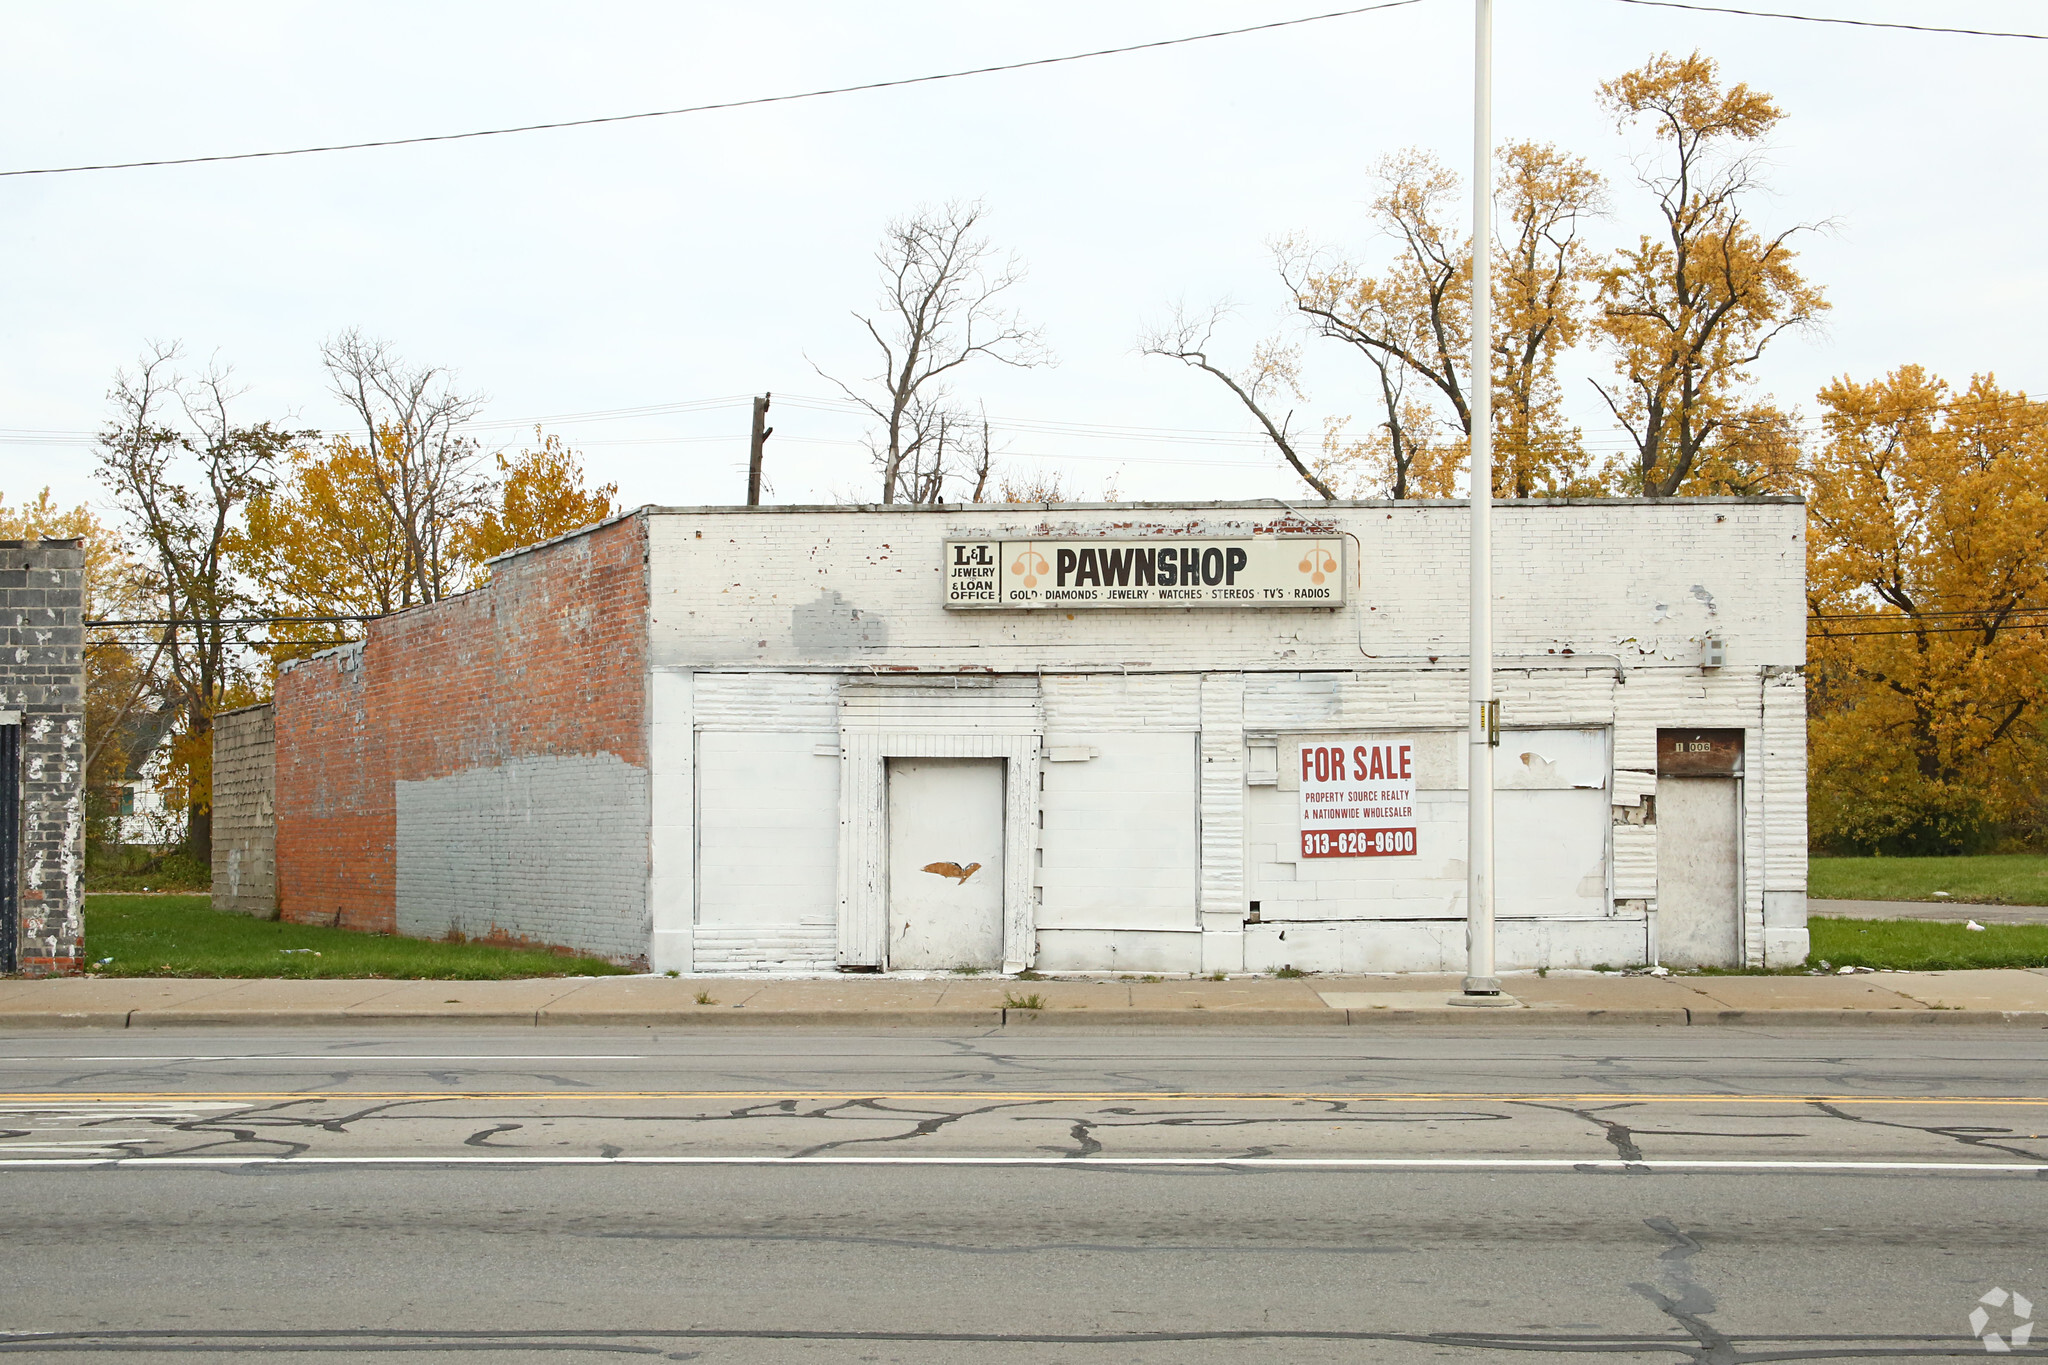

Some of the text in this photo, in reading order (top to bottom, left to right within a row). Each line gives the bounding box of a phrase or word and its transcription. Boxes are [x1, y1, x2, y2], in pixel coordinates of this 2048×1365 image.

[954, 546, 993, 566] L&L
[951, 567, 996, 578] JEWELRY
[1057, 547, 1248, 587] PAWNSHOP
[952, 581, 993, 591] & LOAN
[950, 591, 996, 600] OFFICE
[1045, 590, 1098, 600] DIAMONDS
[1107, 590, 1149, 600] JEWELRY
[1158, 589, 1202, 599] WATCHES
[1211, 589, 1255, 599] STEREOS
[1263, 588, 1284, 598] TV'S
[1294, 588, 1330, 598] RADIOS
[1302, 745, 1412, 782] FOR SALE
[1305, 790, 1410, 803] PROPERTY SOURCE REALTY
[1304, 806, 1412, 819] A NATIONWIDE WHOLESALER
[1304, 831, 1413, 855] 313-626-9600
